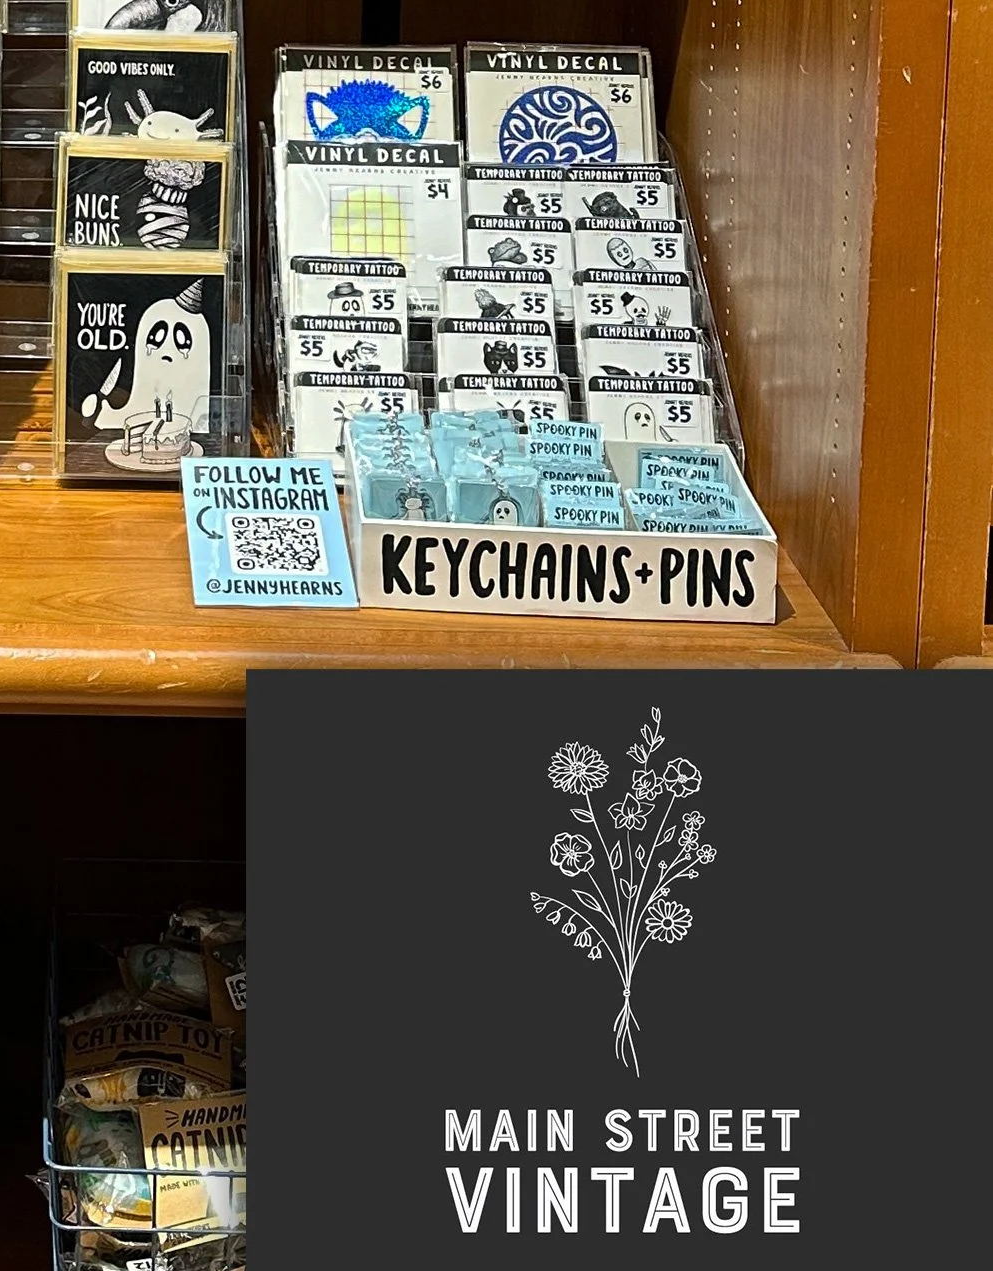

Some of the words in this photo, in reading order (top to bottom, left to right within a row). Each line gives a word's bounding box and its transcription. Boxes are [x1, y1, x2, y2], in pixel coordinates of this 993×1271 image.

[88, 61, 117, 74] GOOD
[120, 62, 148, 75] VIBES
[150, 63, 175, 76] ONLY.
[304, 54, 364, 70] VINYL
[372, 56, 434, 71] DECAL
[487, 54, 547, 70] VINYL
[557, 56, 623, 71] DECAL
[421, 75, 442, 89] $6
[611, 89, 632, 103] $6
[306, 147, 368, 162] VINYL
[377, 148, 445, 163] DECAL
[475, 168, 526, 179] TEMPORARY
[528, 168, 563, 179] TATTOO
[573, 169, 623, 180] TEMPORARY
[626, 170, 662, 181] TATTOO
[427, 183, 448, 199] $4
[637, 189, 658, 205] $5
[75, 194, 120, 220] NICE
[541, 198, 562, 214] $5
[474, 217, 526, 229] TEMPORARY
[528, 219, 563, 230] TATTOO
[585, 219, 637, 230] TEMPORARY
[640, 220, 675, 231] TATTOO
[75, 222, 124, 246] BUNS.
[533, 248, 555, 266] $5
[654, 242, 676, 259] $5
[308, 262, 361, 274] TEMPORARY
[364, 263, 400, 275] TATTOO
[453, 269, 506, 280] TEMPORARY
[509, 271, 545, 282] TATTOO
[589, 270, 645, 283] TEMPORARY
[647, 272, 682, 284] TATTOO
[372, 294, 395, 311] $5
[523, 297, 546, 313] $5
[591, 298, 613, 315] $5
[77, 303, 126, 327] YOU'RE
[302, 317, 357, 329] TEMPORARY
[360, 320, 395, 332] TATTOO
[453, 321, 507, 332] TEMPORARY
[510, 323, 546, 334] TATTOO
[596, 325, 651, 338] TEMPORARY
[654, 327, 691, 339] TATTOO
[77, 329, 129, 350] OLD.
[300, 340, 324, 357] $5
[523, 351, 546, 368] $5
[667, 358, 691, 375] $5
[310, 373, 366, 385] TEMPORARY
[369, 375, 405, 386] TATTOO
[462, 376, 518, 388] TEMPORARY
[520, 378, 557, 388] TATTOO
[598, 378, 654, 391] TEMPORARY
[657, 380, 694, 392] TATTOO
[381, 397, 404, 413] $5
[531, 406, 554, 420] $5
[668, 405, 692, 423] $5
[536, 422, 577, 436] SPOOKY
[579, 427, 597, 439] PIN
[530, 442, 570, 455] SPOOKY
[573, 443, 592, 457] PIN
[194, 466, 280, 484] FOLLOW
[290, 467, 323, 485] ME
[647, 464, 687, 477] SPOOKY
[193, 488, 210, 497] ON
[213, 486, 329, 511] INSTAGRAM
[550, 484, 592, 496] SPOOKY
[595, 485, 614, 498] PIN
[678, 488, 717, 504] SPOOKY
[719, 496, 736, 513] PIN
[554, 507, 598, 521] SPOOKY
[600, 510, 619, 525] PIN
[642, 519, 687, 532] SPOOKY
[207, 578, 343, 596] @JENNYHEARNS
[72, 1022, 168, 1049] CATNIP
[180, 1025, 226, 1053] TOY
